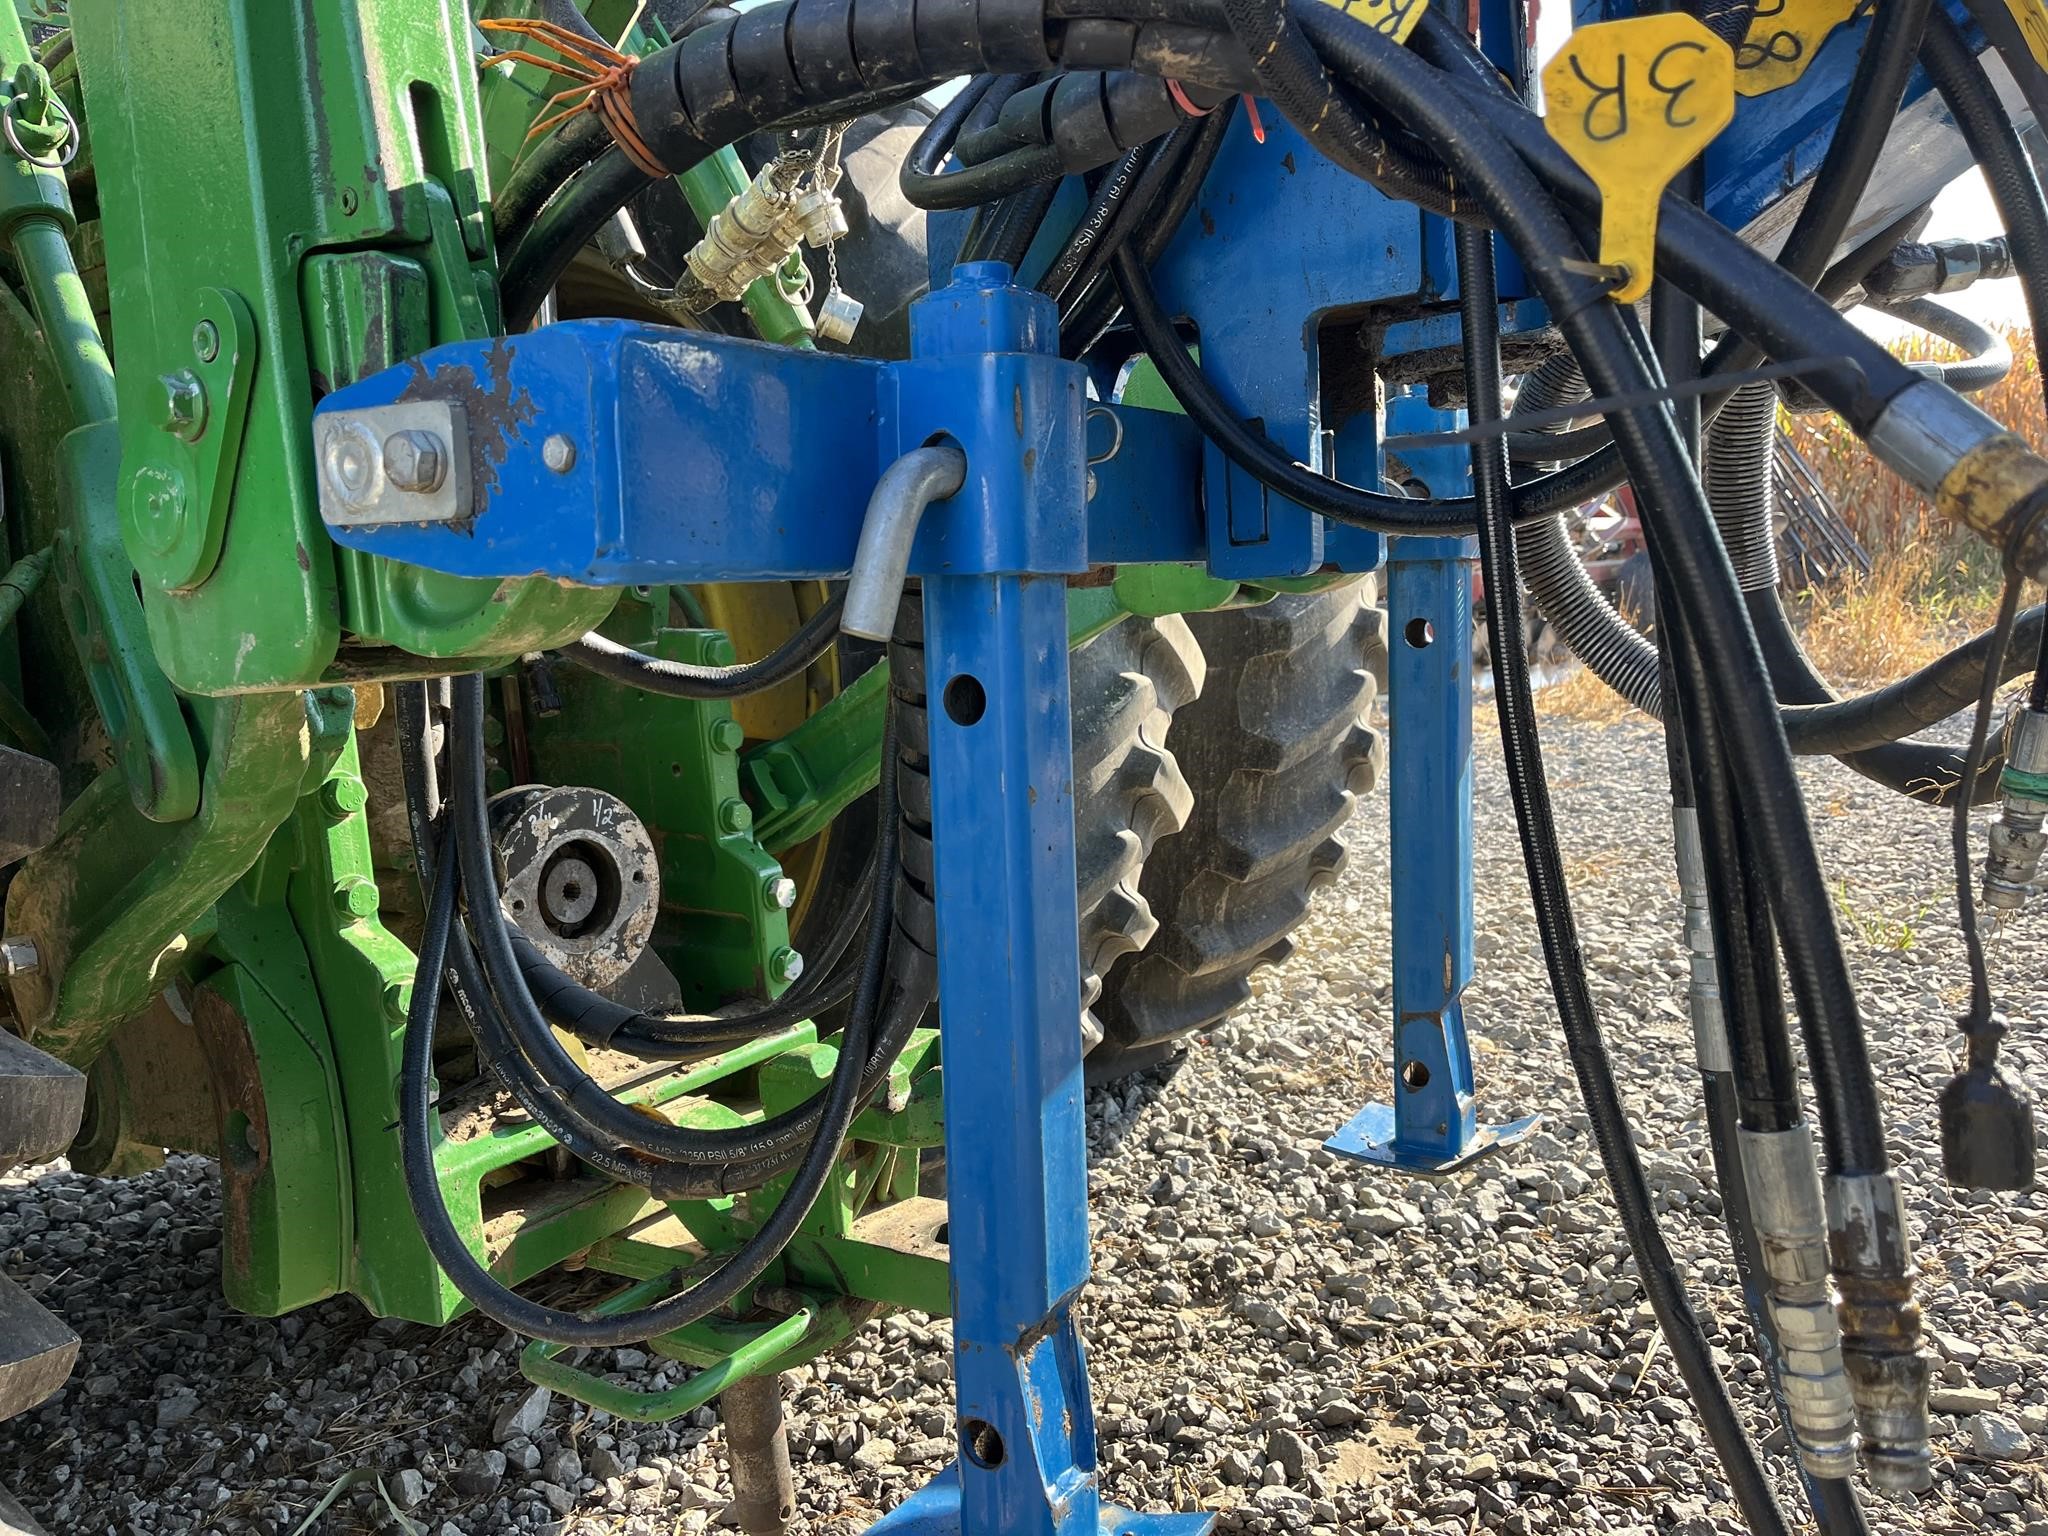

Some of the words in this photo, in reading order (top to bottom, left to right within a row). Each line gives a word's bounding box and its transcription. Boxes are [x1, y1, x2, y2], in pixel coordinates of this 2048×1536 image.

[1568, 41, 1708, 142] 3R
[591, 1151, 611, 1169] 22.5
[707, 1150, 728, 1162] PSI)
